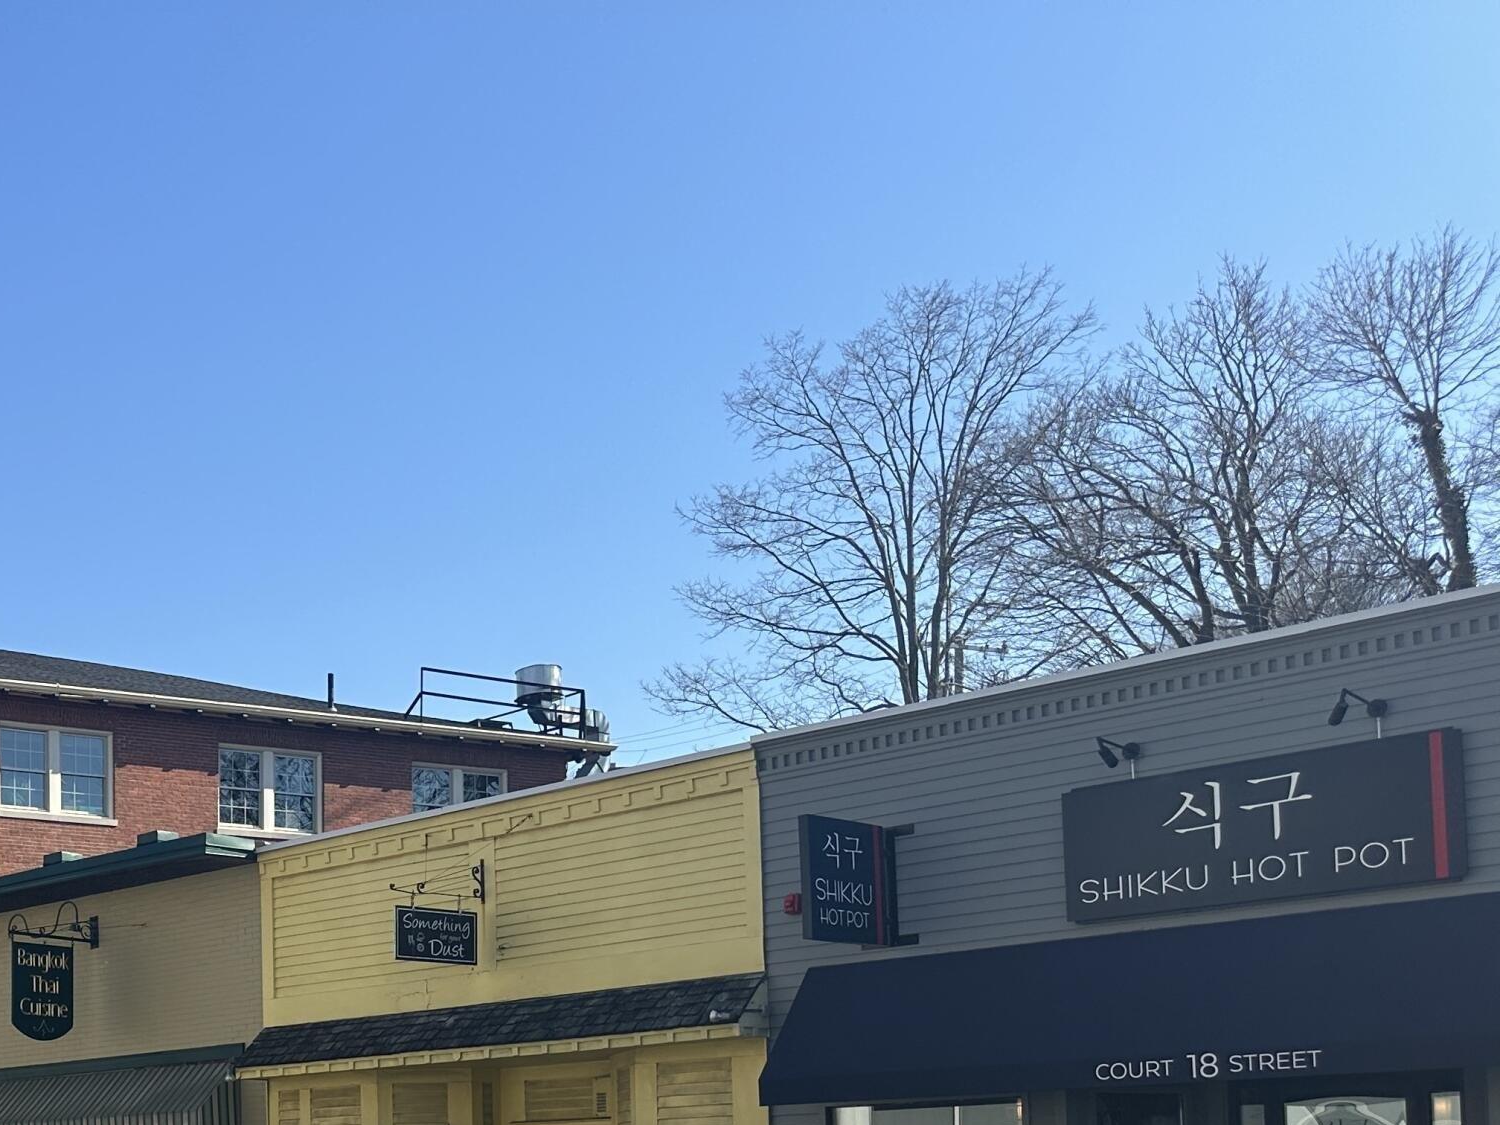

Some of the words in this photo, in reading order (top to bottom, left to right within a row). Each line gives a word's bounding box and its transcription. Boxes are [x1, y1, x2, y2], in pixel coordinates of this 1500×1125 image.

[1162, 771, 1312, 850] 식구
[822, 832, 863, 870] 식구
[1079, 864, 1209, 904] SHIKKU
[1230, 851, 1310, 885] HOT
[1334, 837, 1415, 874] POT
[815, 878, 872, 906] SHIKKU
[402, 913, 470, 939] Something
[820, 907, 844, 926] HOT
[847, 911, 871, 928] POT
[18, 948, 69, 973] Bangkok
[428, 939, 465, 958] Dust
[30, 975, 60, 994] Thai
[20, 997, 68, 1018] Cuisine
[1095, 1059, 1174, 1081] COURT
[1186, 1053, 1219, 1079] 18
[1229, 1049, 1322, 1073] STREET
